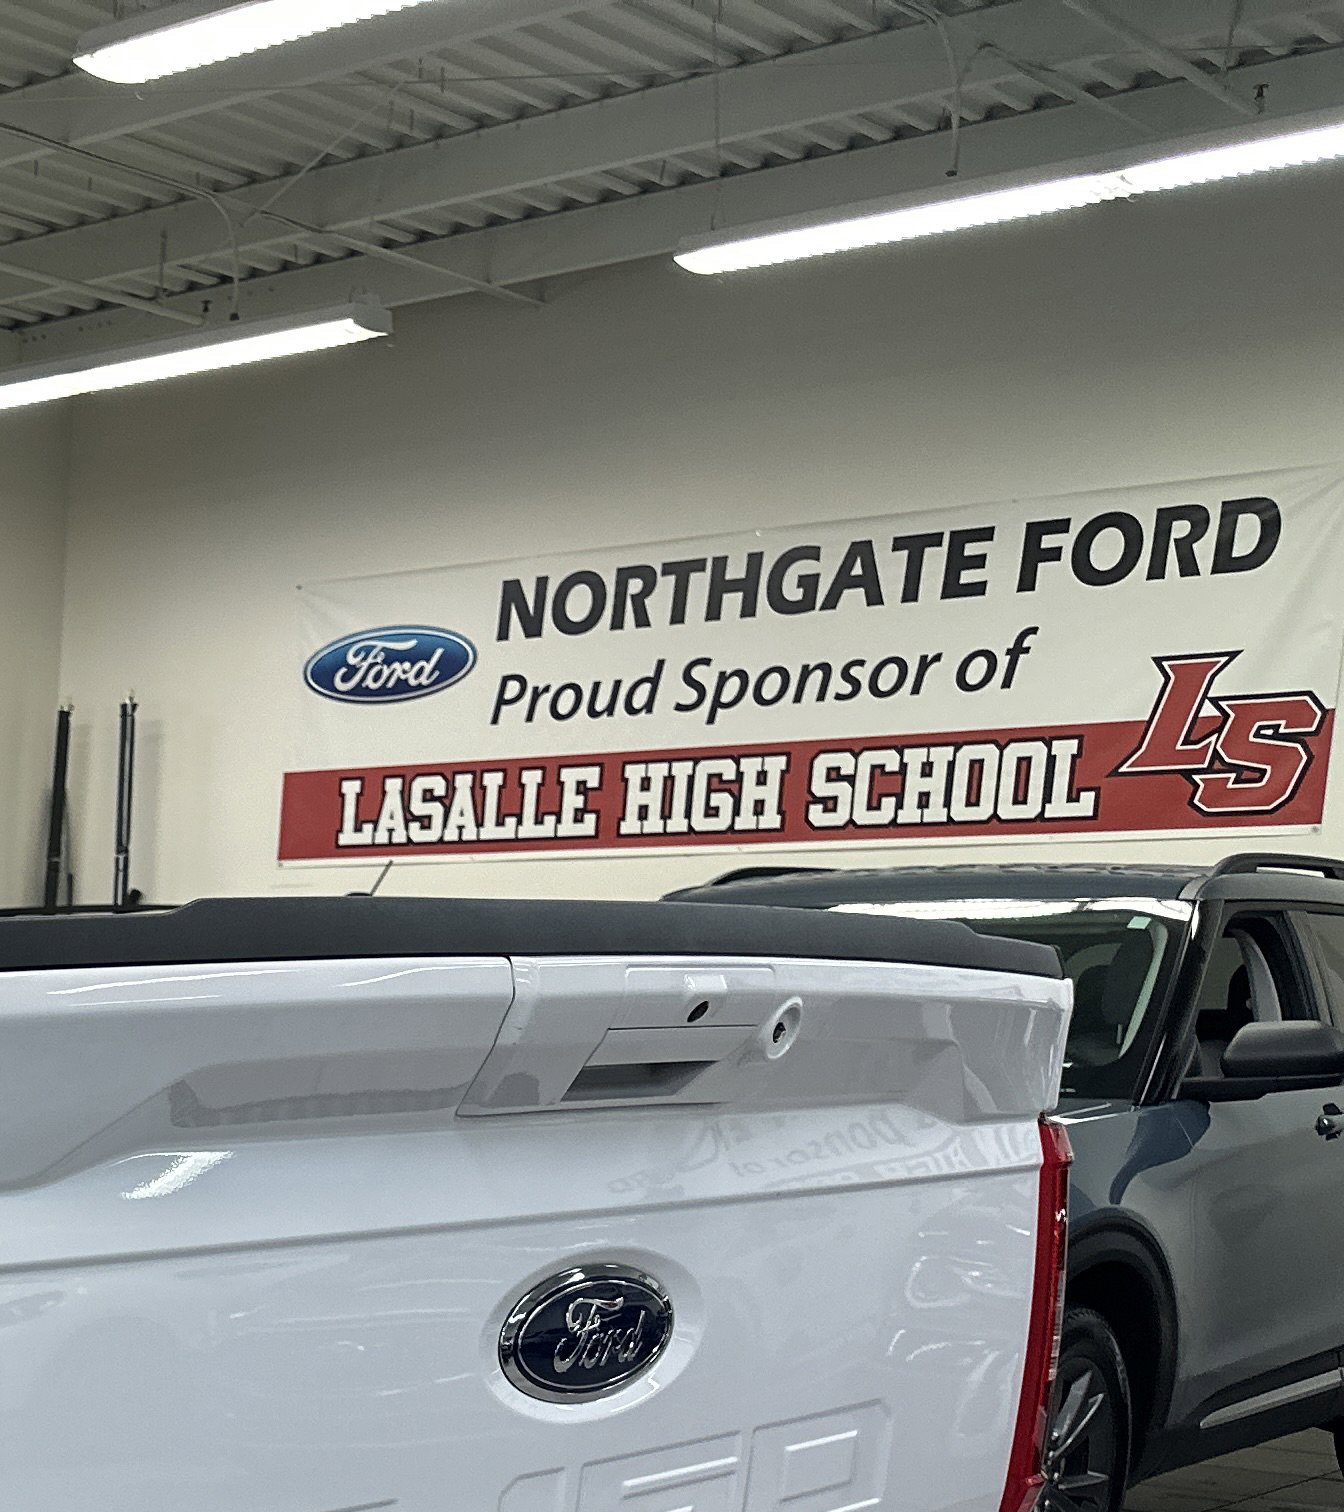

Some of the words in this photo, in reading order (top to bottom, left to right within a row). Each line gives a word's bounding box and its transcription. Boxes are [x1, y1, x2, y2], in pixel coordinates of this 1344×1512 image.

[496, 526, 996, 641] NORTHGATE
[1016, 496, 1282, 593] FORD
[333, 638, 445, 693] Ford
[490, 657, 666, 726] Proud
[673, 651, 944, 725] Sponsor
[955, 626, 1040, 692] of
[1105, 649, 1329, 817] LS
[335, 763, 604, 848] LASALLE
[618, 752, 792, 838] HIGH
[804, 735, 1101, 832] SCHOOL
[553, 1296, 646, 1374] Ford
